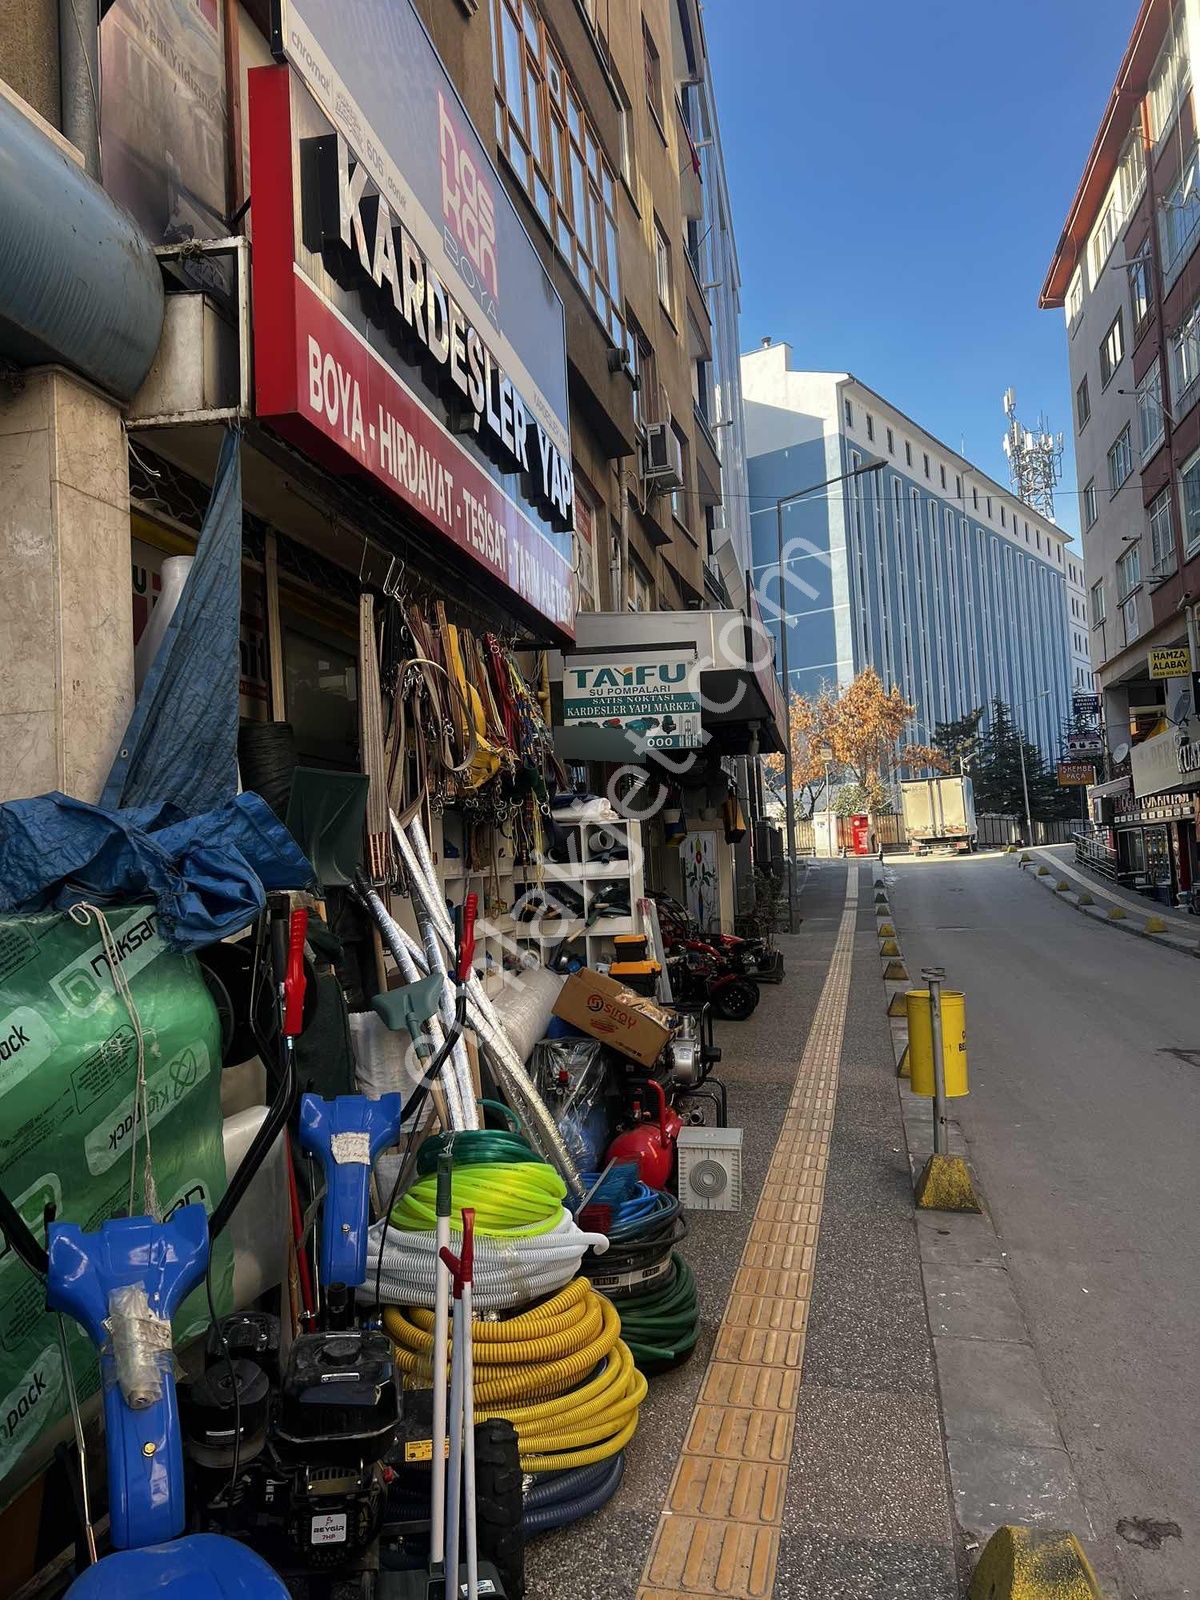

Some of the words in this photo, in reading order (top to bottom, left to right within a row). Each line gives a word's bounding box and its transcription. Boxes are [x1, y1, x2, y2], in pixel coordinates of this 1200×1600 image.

[443, 224, 500, 331] BOYA
[337, 133, 529, 473] KARDEŞLER
[308, 334, 366, 452] BOYA
[378, 404, 454, 528] HIRDAVAT
[462, 487, 507, 573] TESİSAT
[1153, 650, 1186, 661] HAMZA
[1153, 660, 1188, 671] ALABAY
[589, 688, 604, 697] SU
[607, 685, 671, 696] POMPALARI
[627, 694, 674, 703] NOKTASI
[567, 705, 627, 717] KARDEŞLER
[628, 704, 651, 713] YAPI
[653, 701, 697, 712] MARKET
